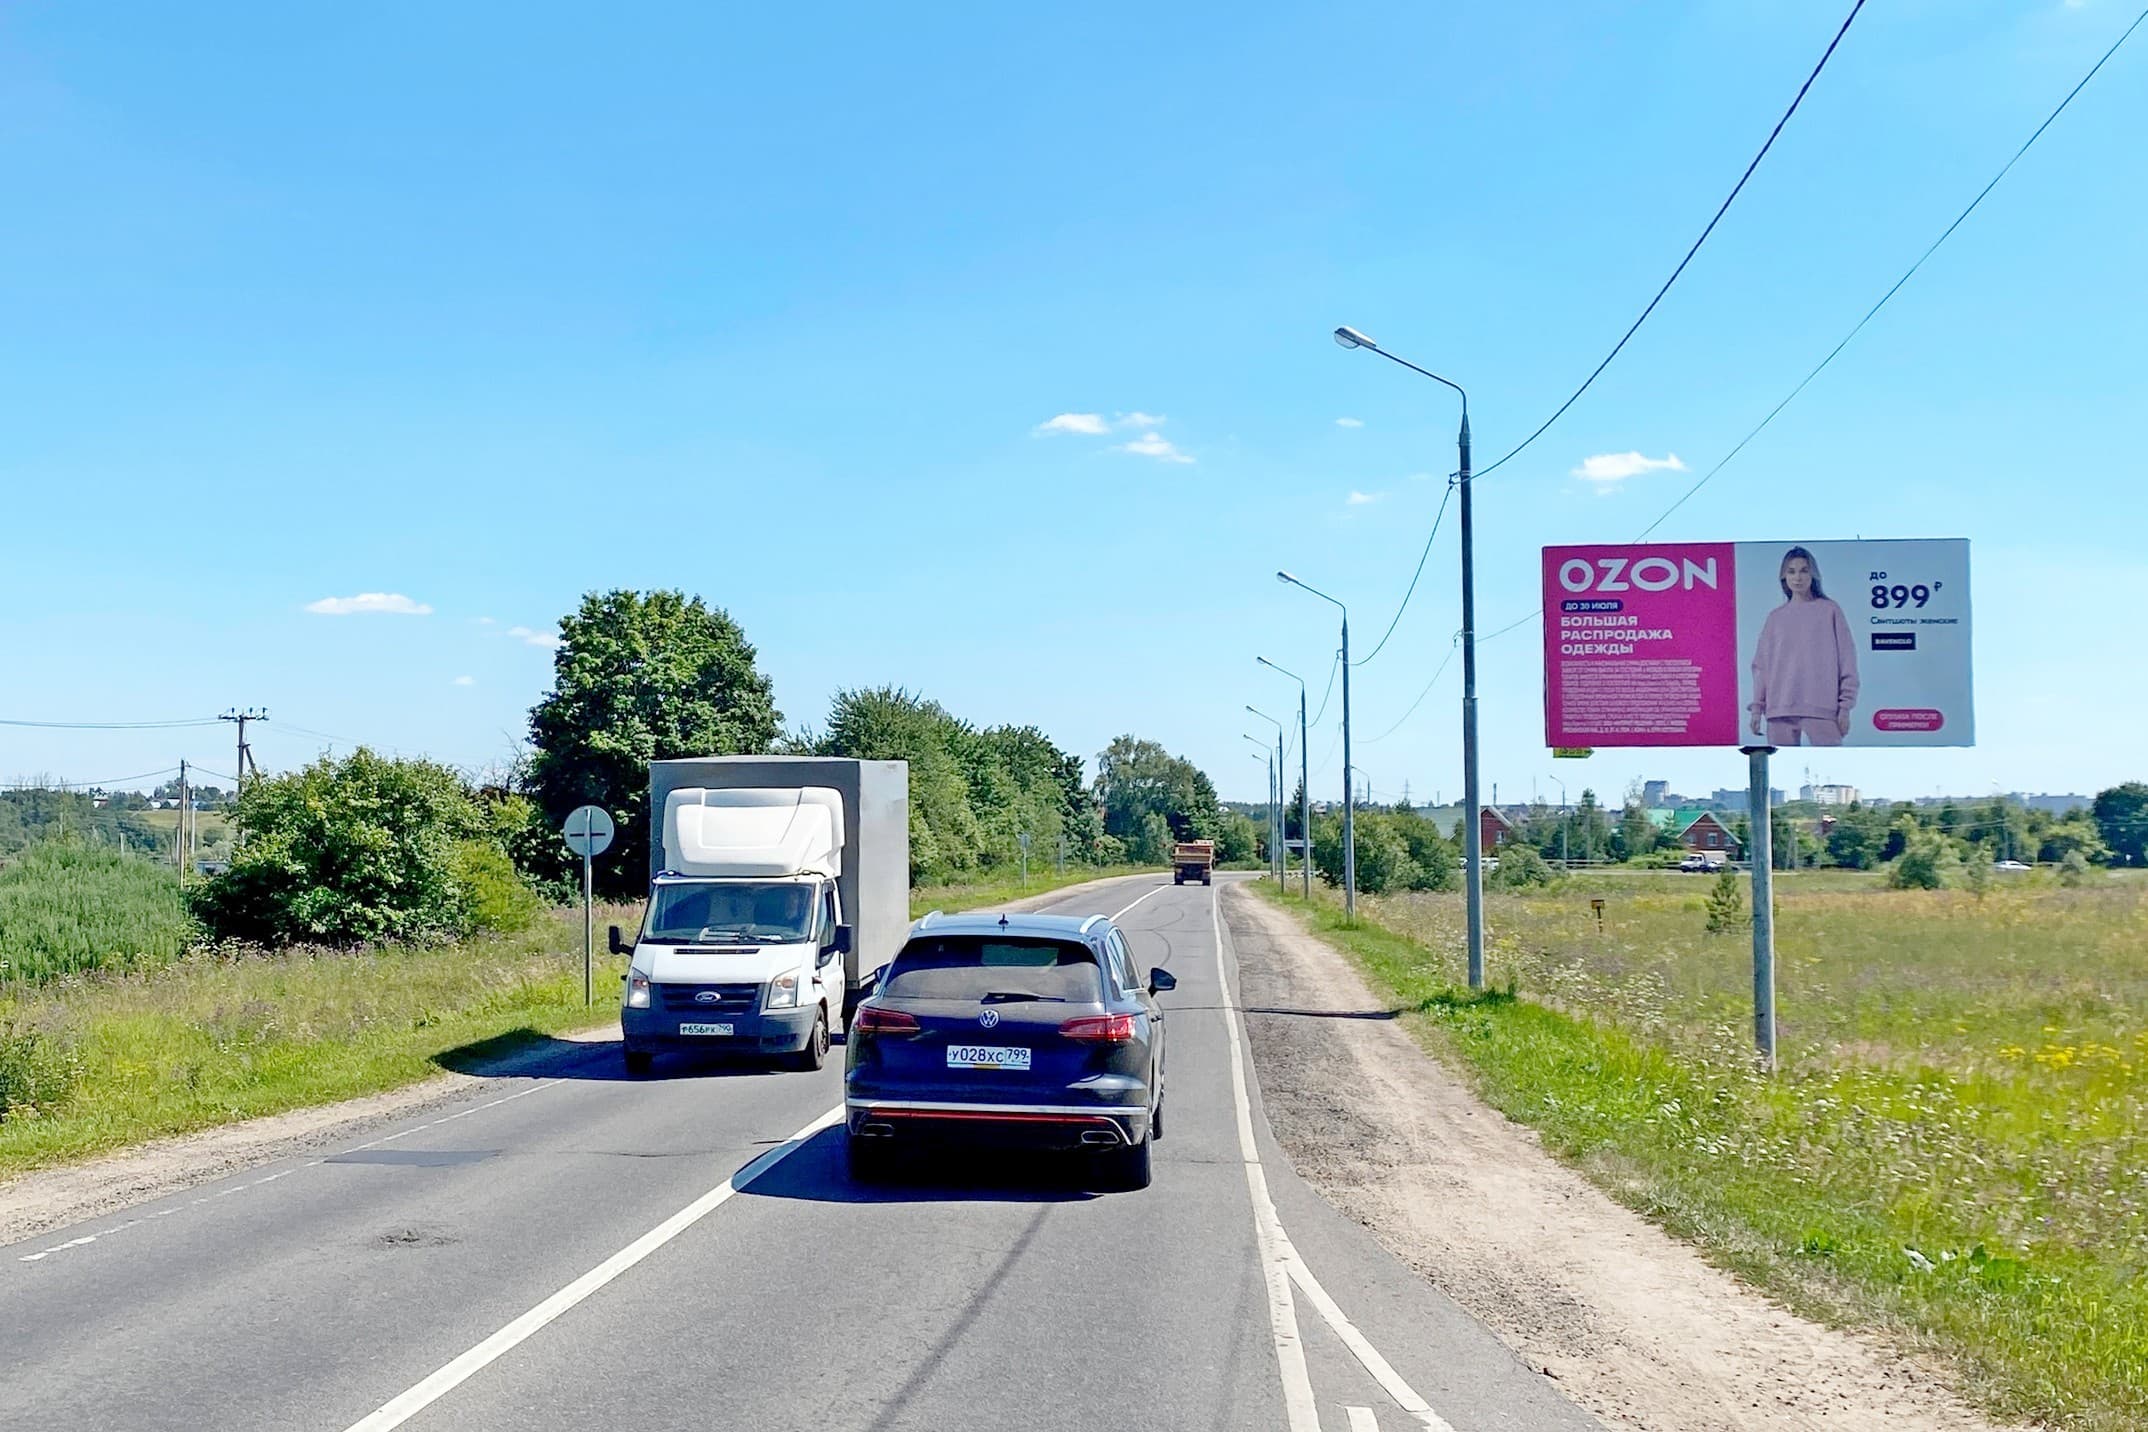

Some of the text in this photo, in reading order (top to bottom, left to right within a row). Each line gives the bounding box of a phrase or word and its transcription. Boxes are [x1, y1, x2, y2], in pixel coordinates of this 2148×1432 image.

[1559, 557, 1718, 592] OZON
[1871, 584, 1931, 609] 899
[1565, 602, 1579, 611] ДО
[1591, 602, 1618, 610] ИЮЛЯ
[1560, 615, 1639, 627] БОЛЬШАЯ
[1560, 629, 1673, 642] РАСПРОДАЖА
[1560, 643, 1634, 656] ОДЕЖДЫ
